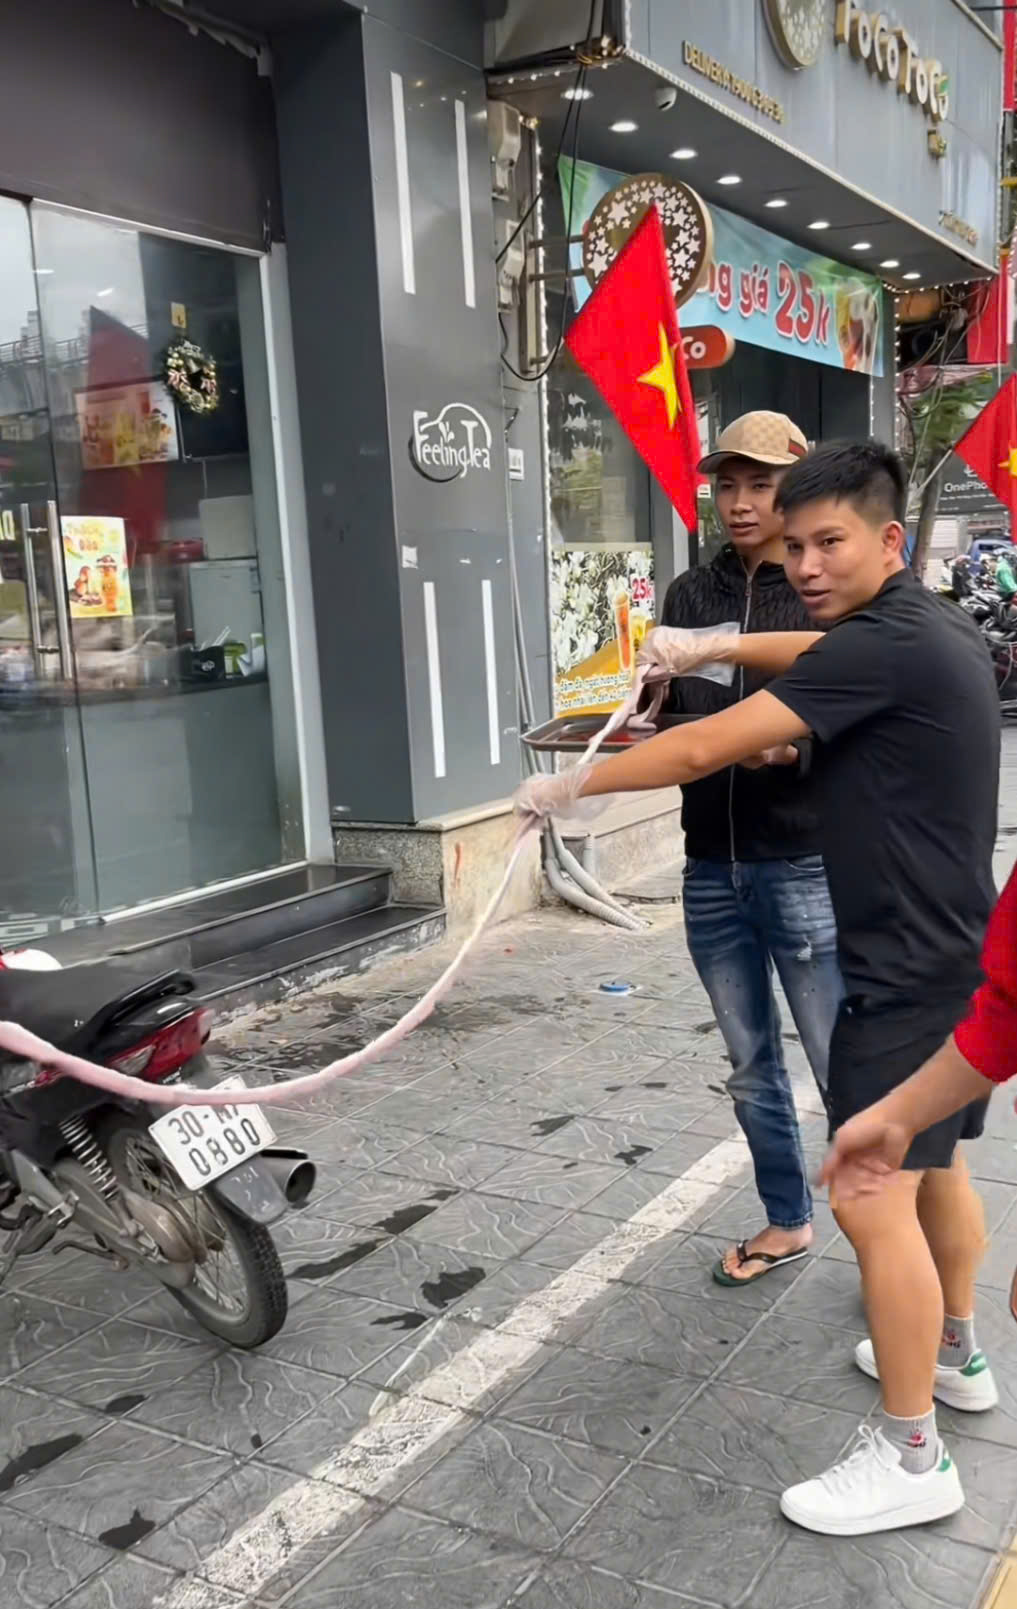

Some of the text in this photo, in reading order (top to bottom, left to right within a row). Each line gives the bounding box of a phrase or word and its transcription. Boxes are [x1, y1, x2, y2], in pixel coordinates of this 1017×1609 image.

[740, 263, 769, 317] giá
[775, 260, 830, 345] 25k
[188, 1118, 260, 1176] 0880
